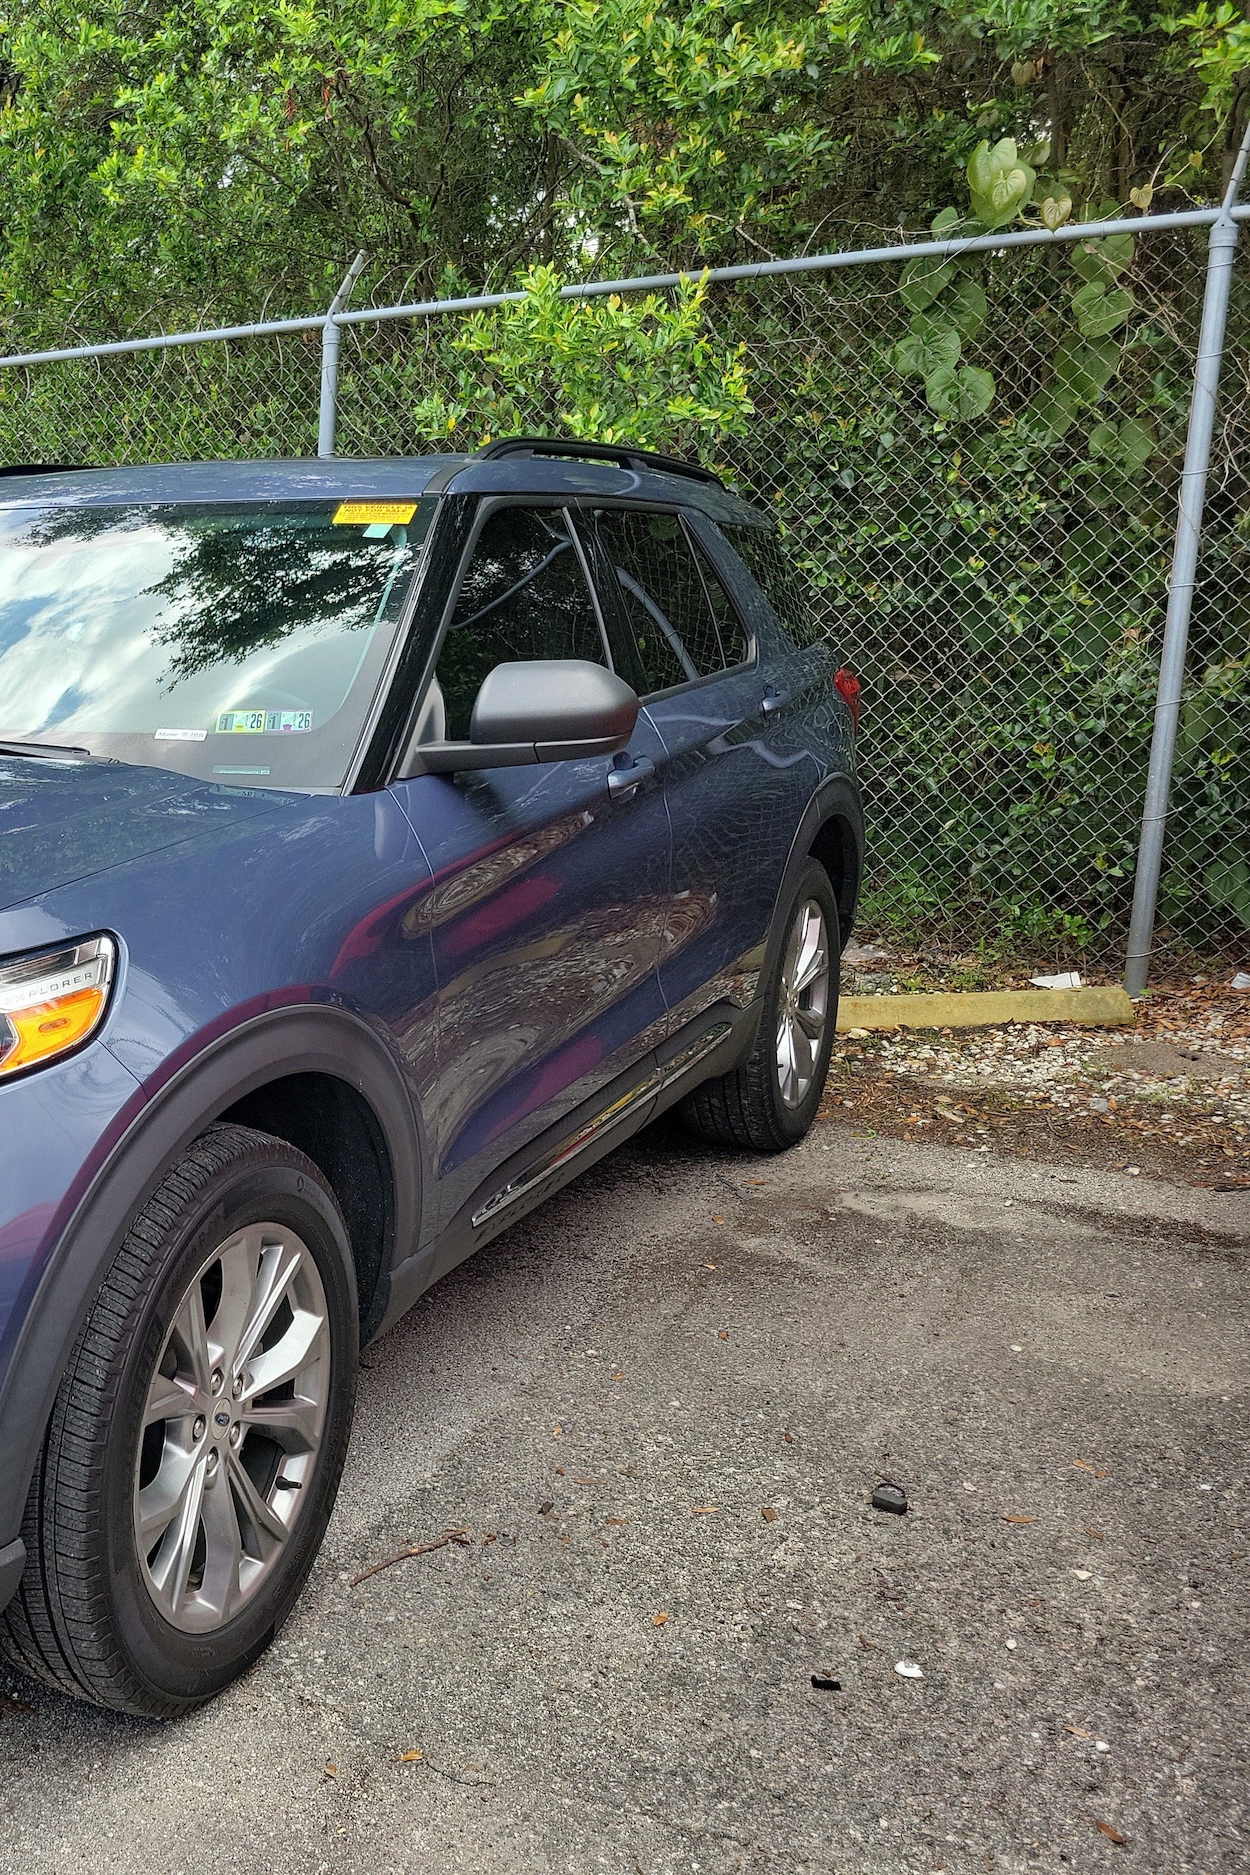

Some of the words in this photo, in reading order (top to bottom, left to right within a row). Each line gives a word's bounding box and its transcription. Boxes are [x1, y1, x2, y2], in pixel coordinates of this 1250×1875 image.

[250, 713, 263, 729] 26
[298, 712, 311, 729] 26
[4, 972, 93, 1004] EXPLORER
